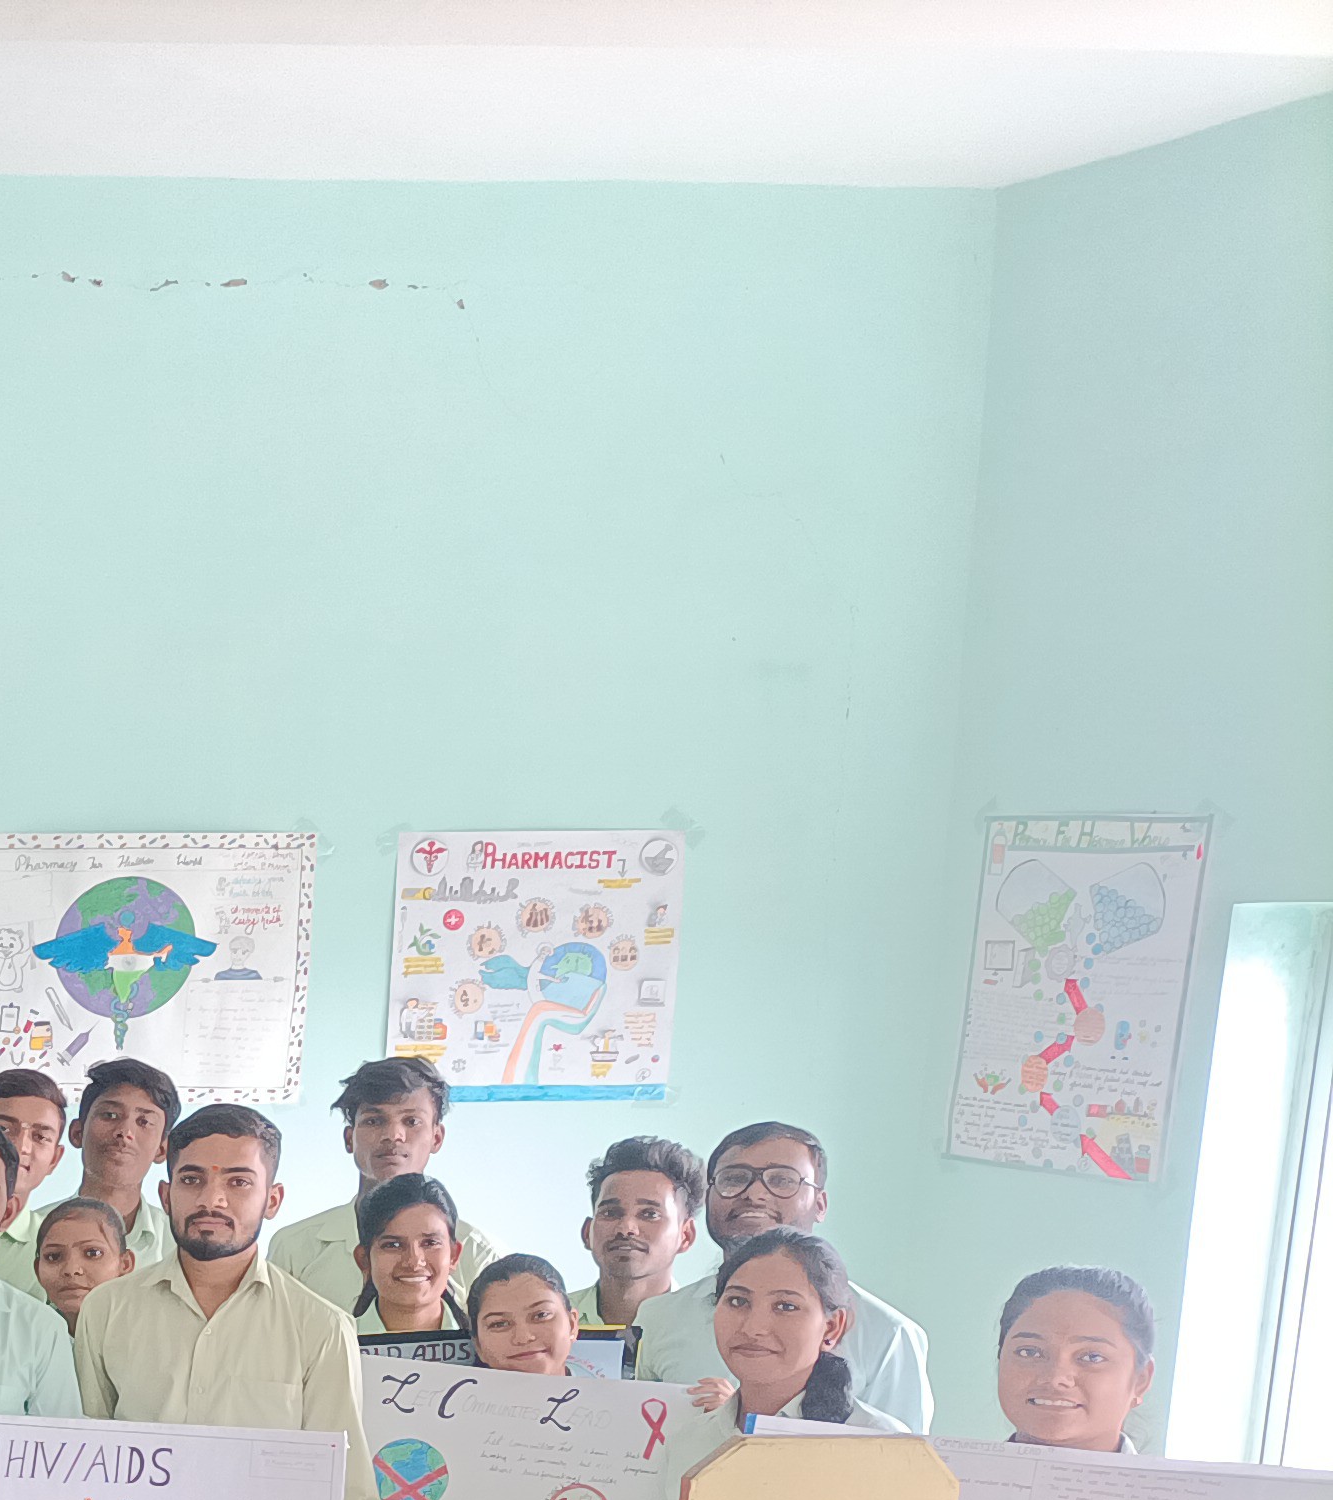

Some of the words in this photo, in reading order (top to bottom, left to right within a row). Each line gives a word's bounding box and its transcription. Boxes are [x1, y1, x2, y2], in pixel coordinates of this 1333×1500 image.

[15, 854, 78, 872] Pharmacy
[482, 841, 618, 870] PHARMACIST
[412, 1343, 472, 1361] AIDS
[4, 1439, 173, 1487] HIV/AIDS
